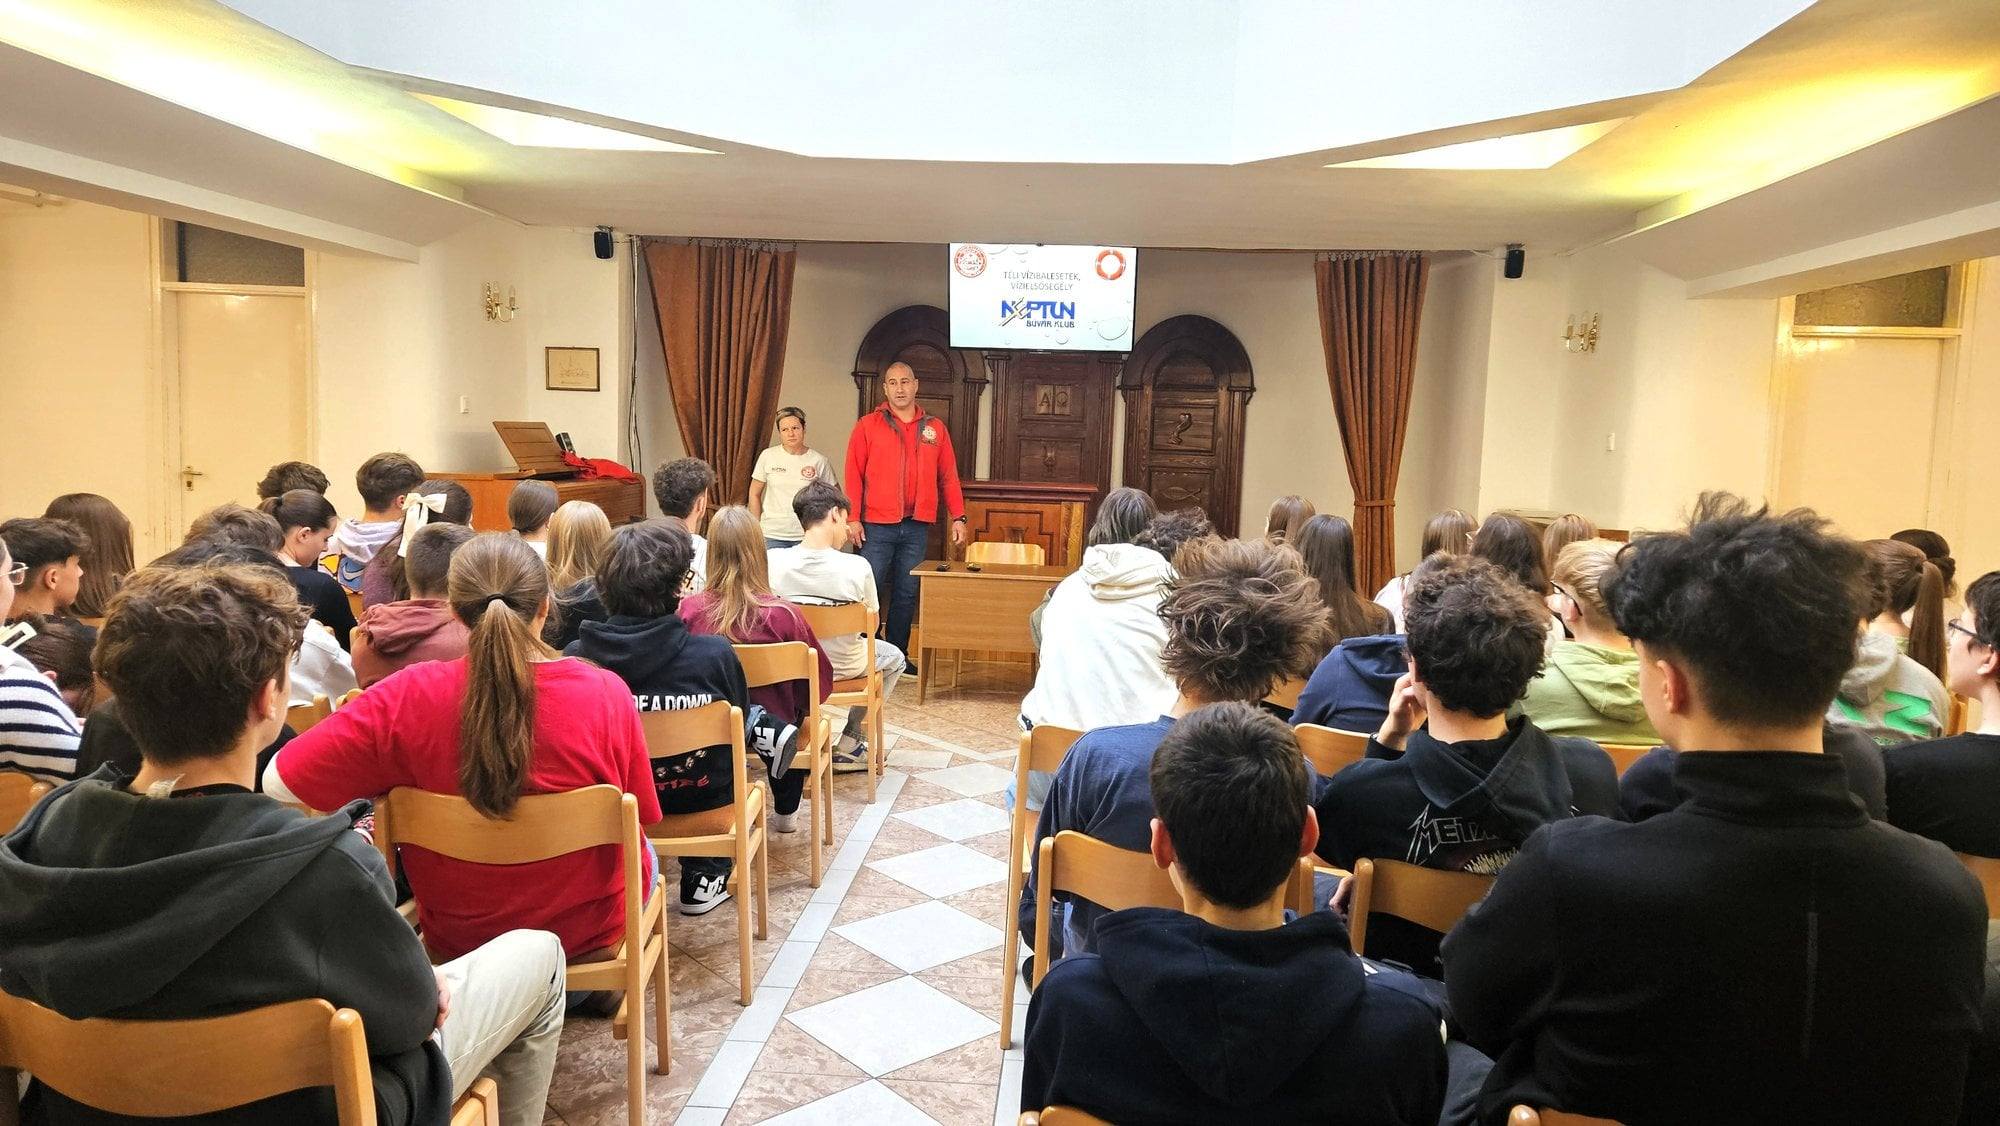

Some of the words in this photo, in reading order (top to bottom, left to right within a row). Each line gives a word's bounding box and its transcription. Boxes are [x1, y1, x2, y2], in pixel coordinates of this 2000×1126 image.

[1054, 320, 1075, 328] KLUB
[651, 695, 662, 712] A
[665, 694, 712, 711] DOWN
